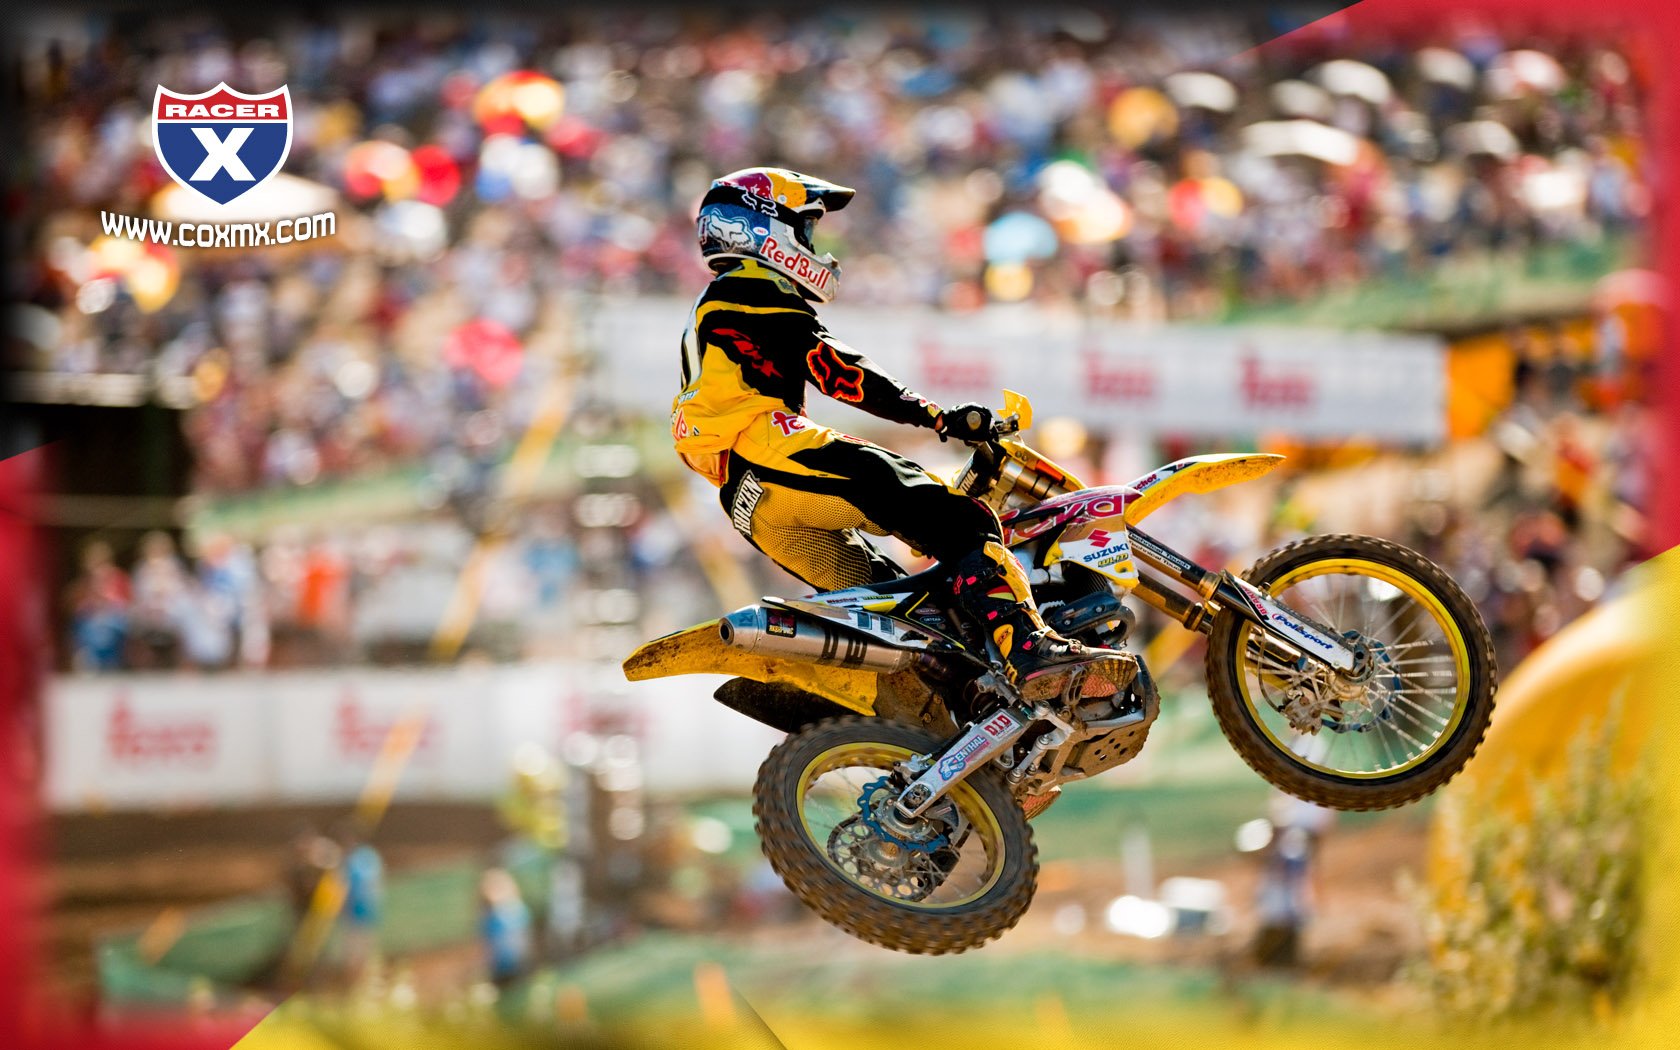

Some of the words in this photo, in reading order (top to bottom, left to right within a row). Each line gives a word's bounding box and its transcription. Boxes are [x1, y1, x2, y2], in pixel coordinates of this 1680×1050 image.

[733, 474, 765, 536] ROCZEN
[1083, 543, 1129, 563] SUZUKI
[1275, 615, 1334, 650] Polisport
